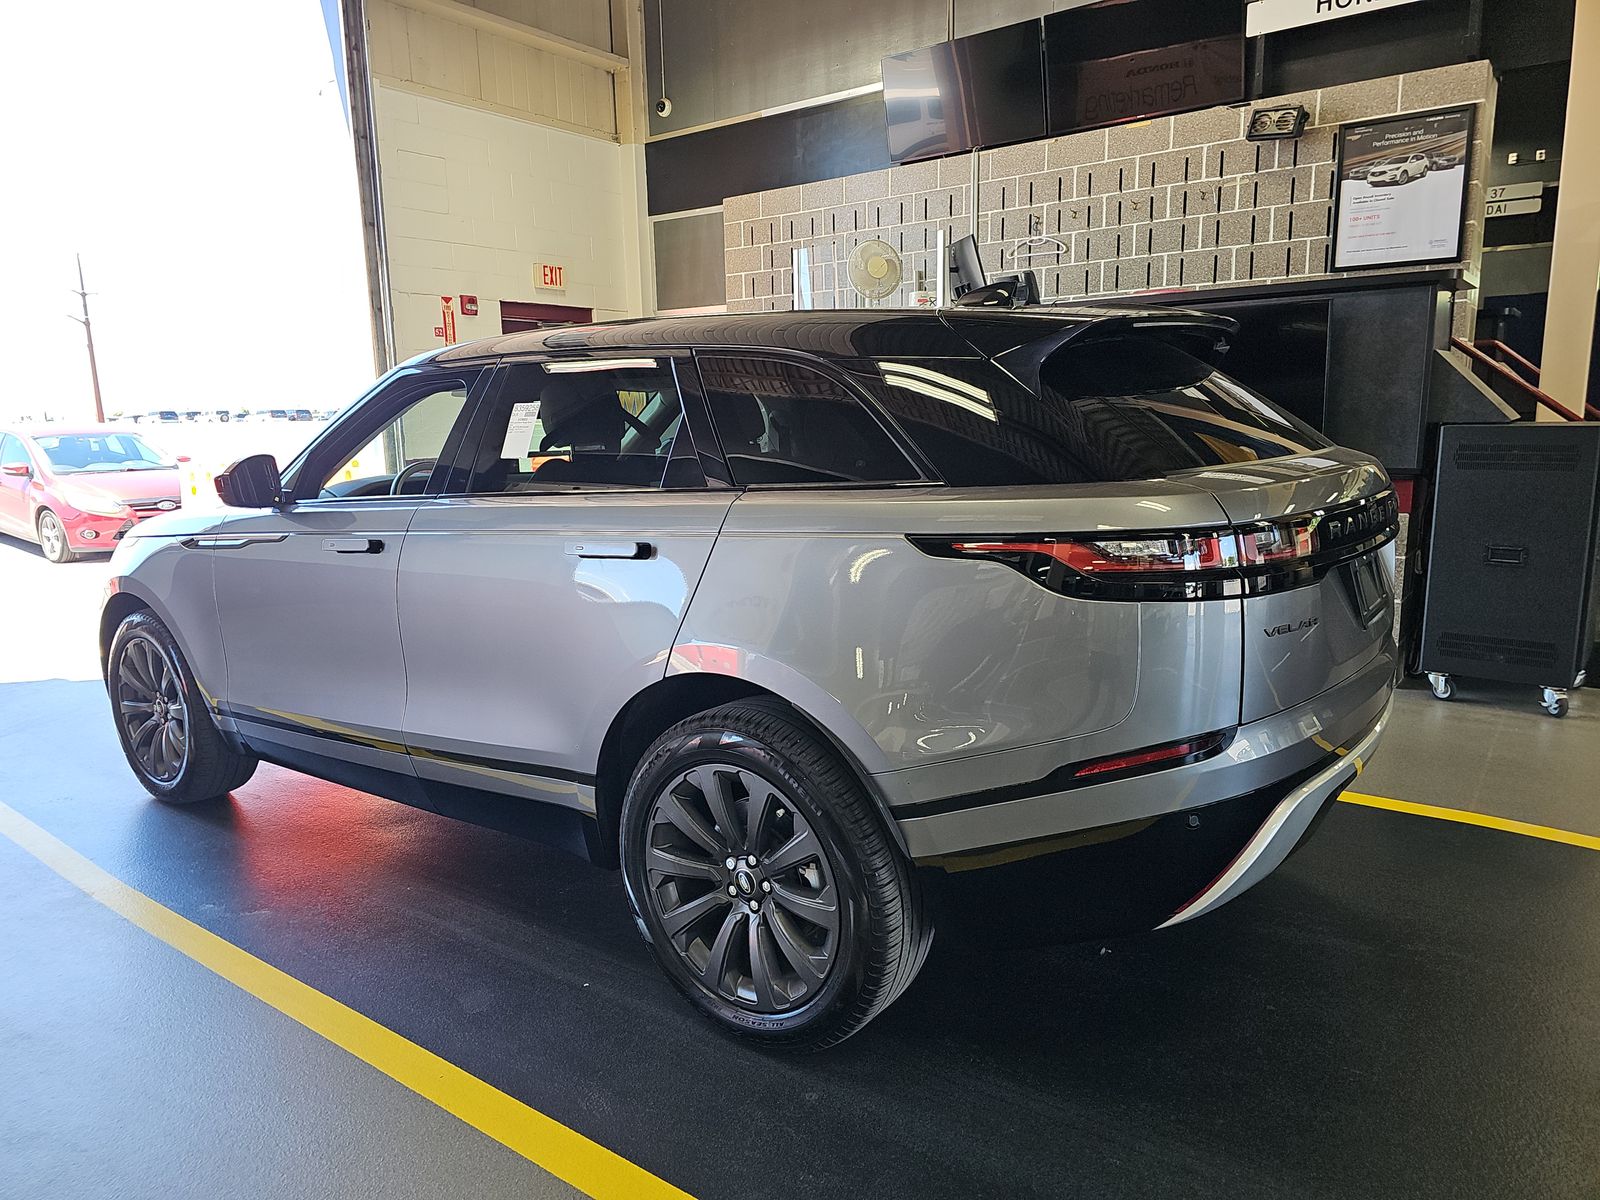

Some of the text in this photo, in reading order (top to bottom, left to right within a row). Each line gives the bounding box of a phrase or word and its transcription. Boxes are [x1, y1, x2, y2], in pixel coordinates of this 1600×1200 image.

[1372, 138, 1410, 147] Performance
[1416, 133, 1438, 141] Motion
[1385, 128, 1424, 140] Precision and
[1490, 188, 1506, 199] 37
[543, 265, 563, 287] EXIT
[1328, 505, 1385, 540] RANGE
[1263, 616, 1319, 638] VELAR
[731, 1014, 769, 1027] SEASON
